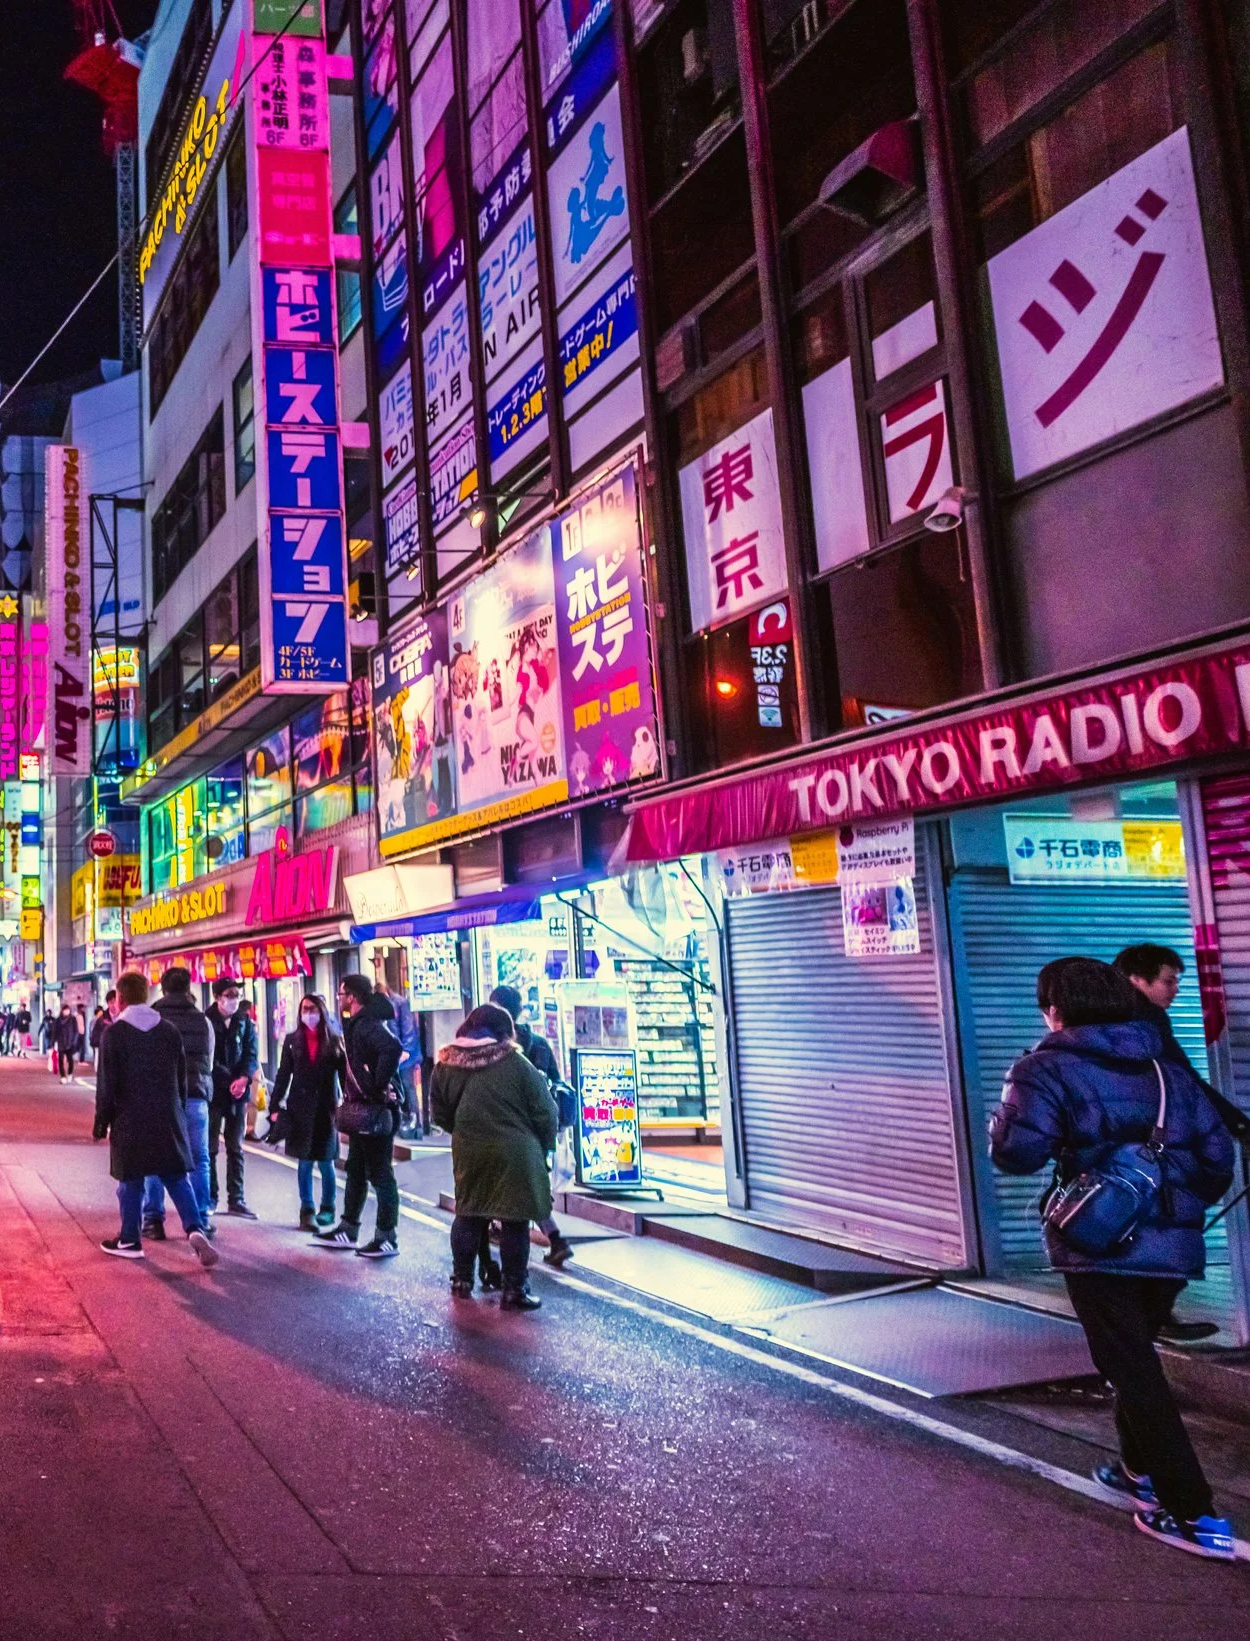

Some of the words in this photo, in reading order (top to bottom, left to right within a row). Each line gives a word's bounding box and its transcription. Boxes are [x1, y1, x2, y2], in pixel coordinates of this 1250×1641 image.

[1020, 188, 1168, 429] ジ
[884, 385, 944, 510] ラ
[63, 448, 79, 568] PACHINKO
[703, 443, 763, 607] 東京
[567, 540, 628, 618] ホビ
[569, 592, 630, 634] HOBBYSTATION
[65, 597, 81, 657] SLOT
[571, 605, 633, 682] ステ
[788, 741, 960, 823] TOKYO
[978, 681, 1202, 786] RADIO
[856, 825, 899, 838] Raspberry
[901, 821, 909, 832] Pi
[1039, 839, 1122, 858] 千石電商
[103, 865, 141, 890] USEFU
[130, 893, 180, 936] PACHINKO
